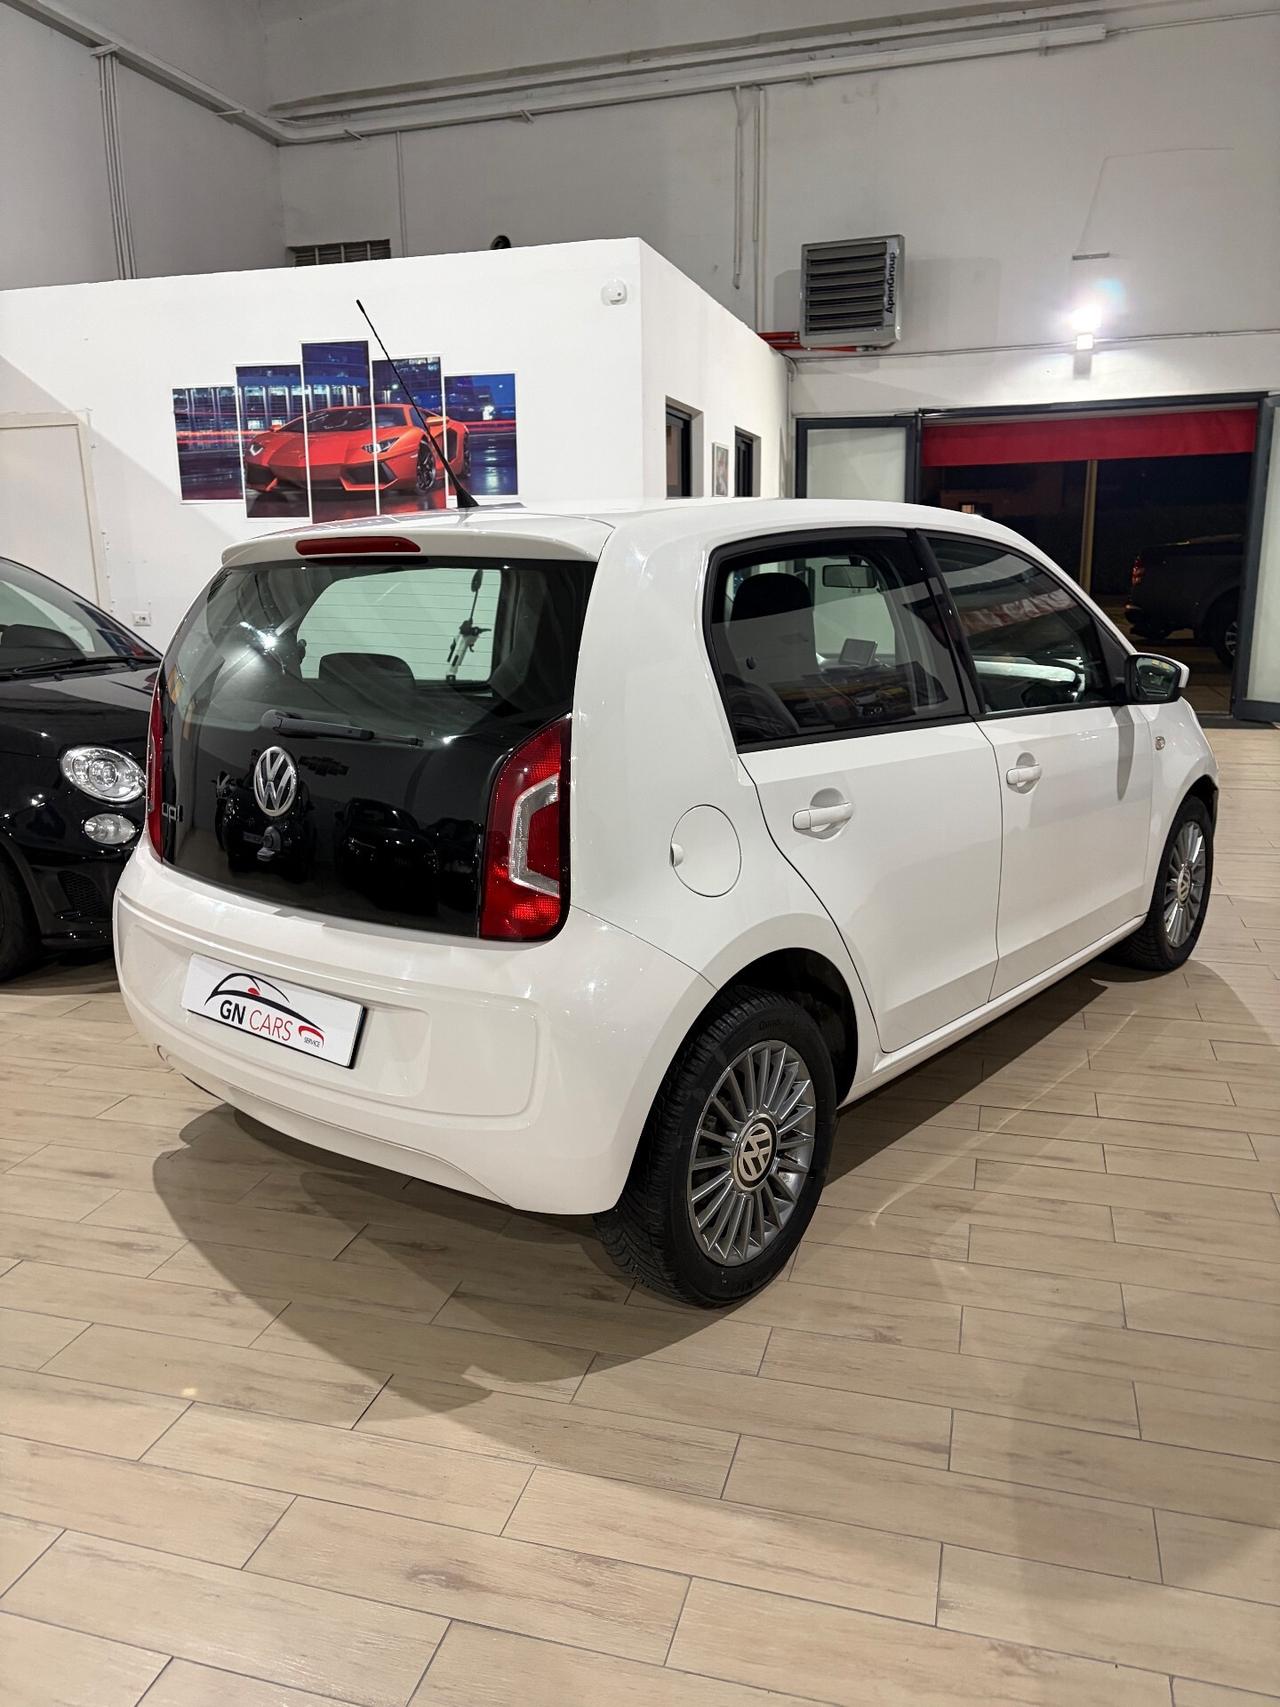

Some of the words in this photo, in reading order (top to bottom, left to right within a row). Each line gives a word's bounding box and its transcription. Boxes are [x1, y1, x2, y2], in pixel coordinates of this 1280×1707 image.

[885, 252, 896, 314] ApenGroup
[220, 1000, 246, 1025] GN
[250, 1009, 293, 1041] CARS
[303, 1037, 321, 1048] SERVICE
